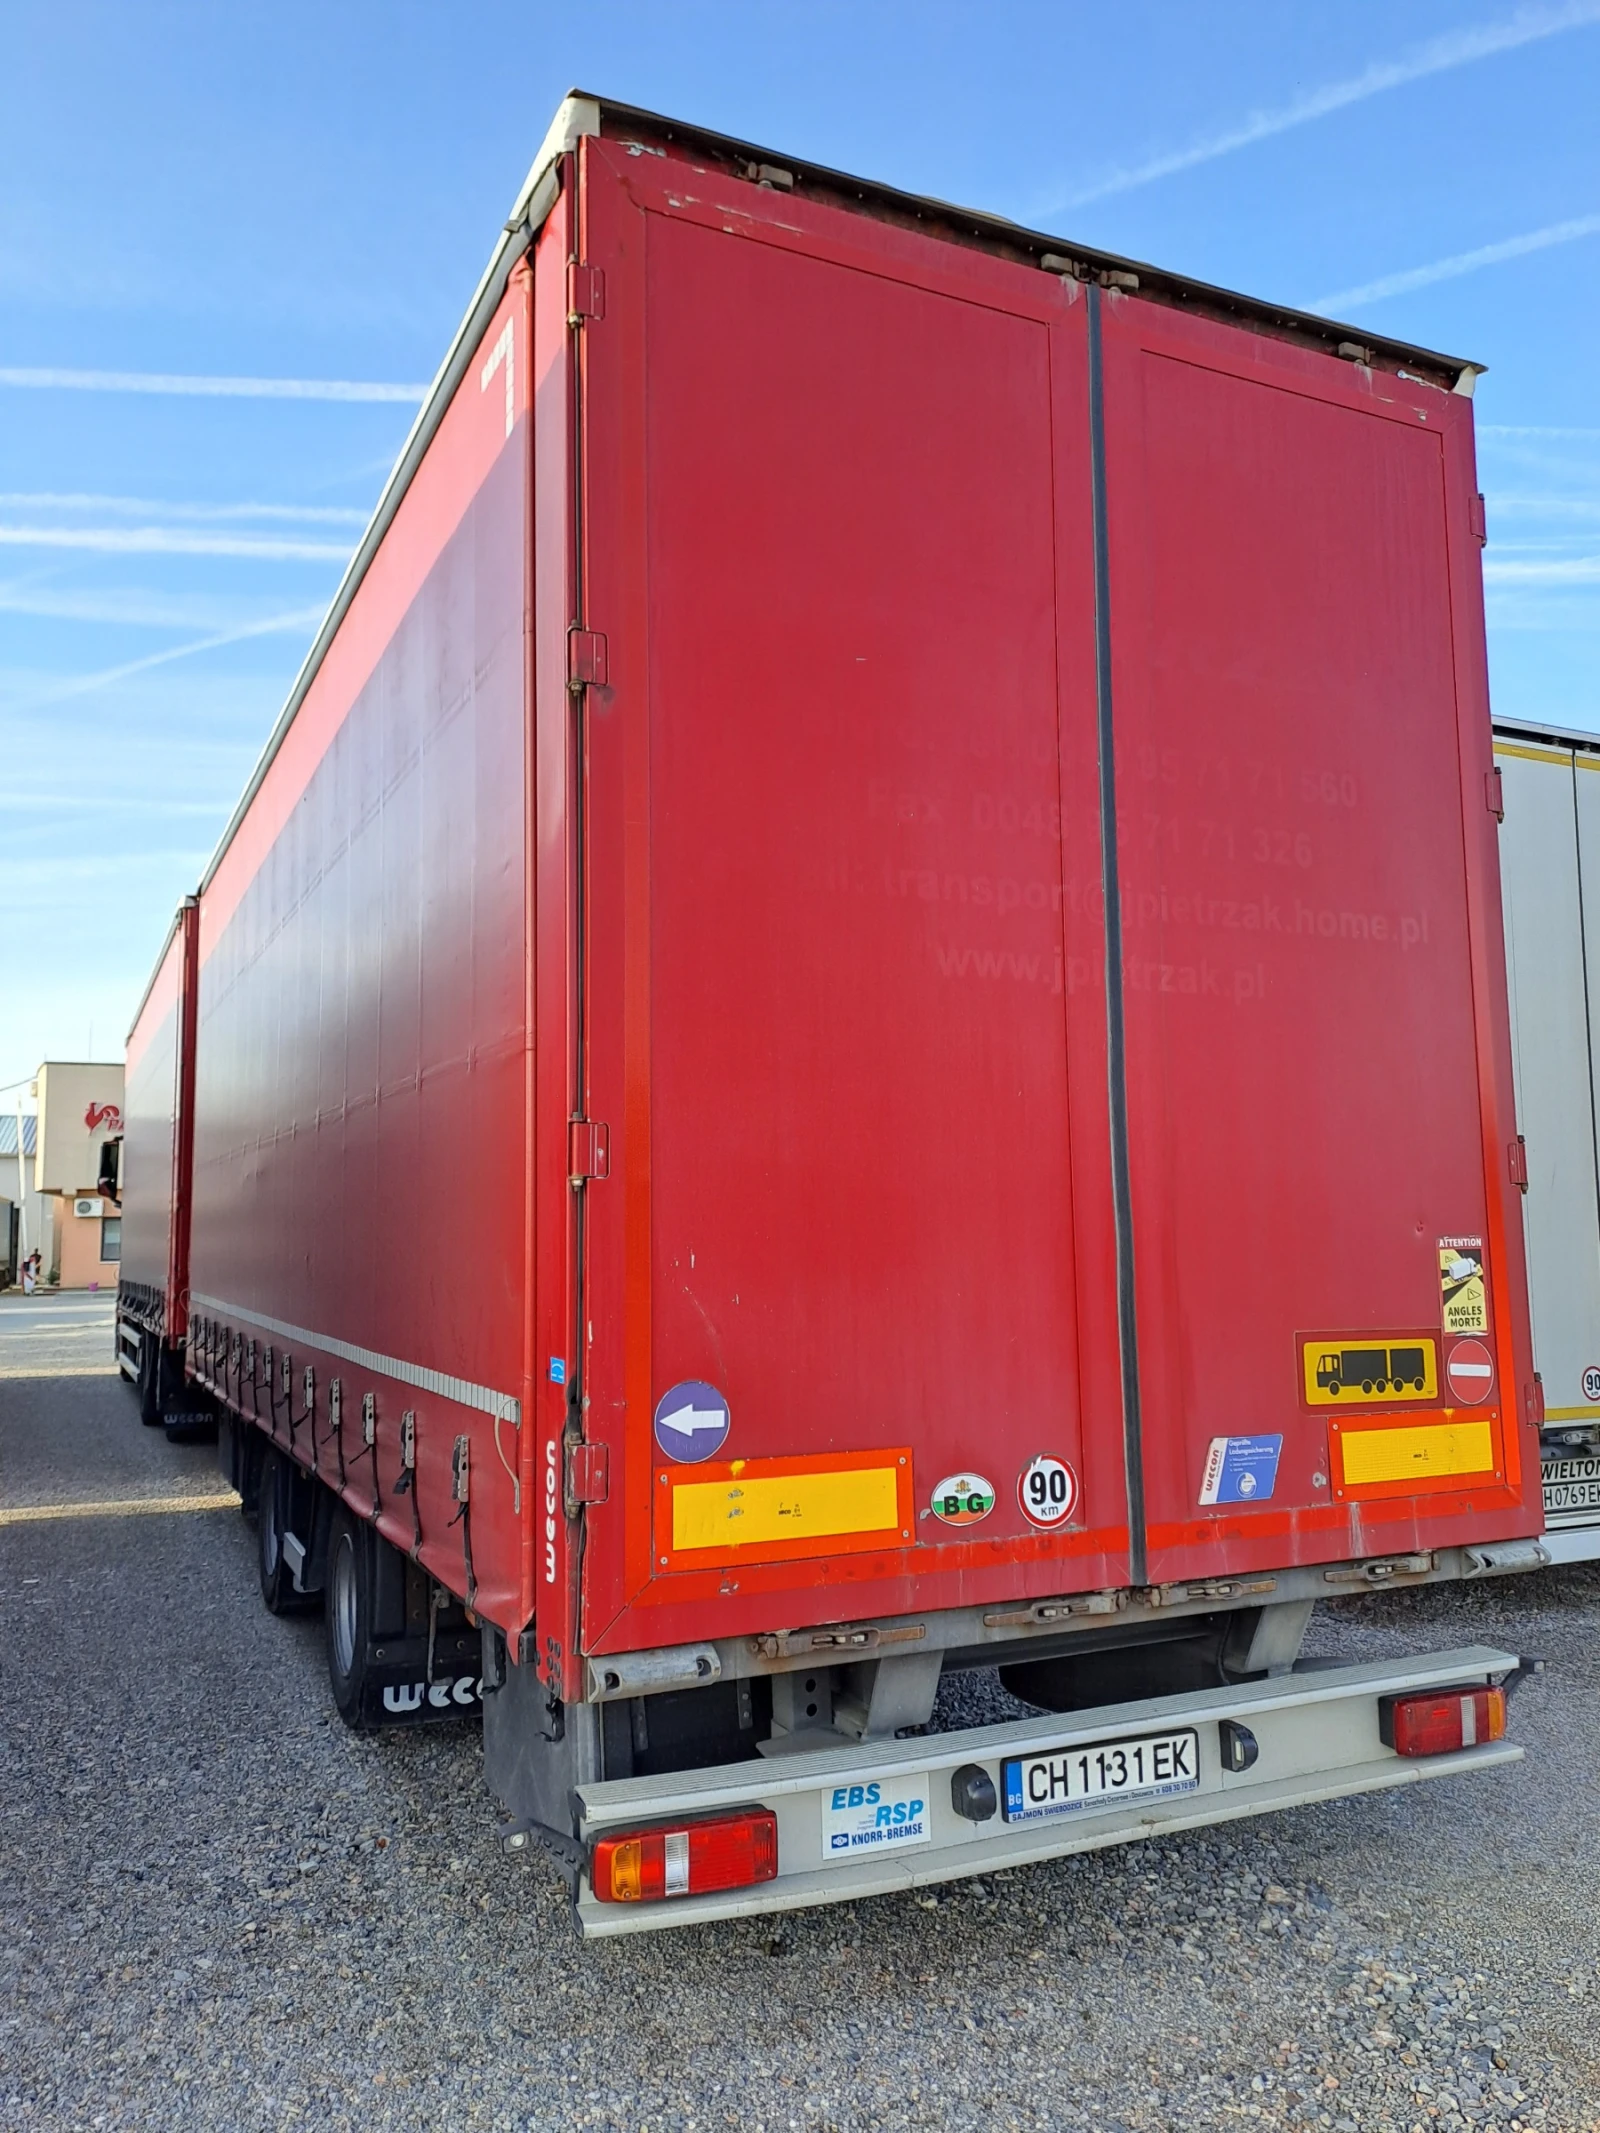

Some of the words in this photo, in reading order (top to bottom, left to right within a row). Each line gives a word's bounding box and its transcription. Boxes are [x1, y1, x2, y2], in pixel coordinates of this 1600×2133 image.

[937, 944, 1266, 1004] www.jpitrzak.pl
[1439, 1237, 1482, 1248] ATTENTION
[1448, 1305, 1482, 1317] ANGLES
[1450, 1316, 1482, 1328] MORTS
[1205, 1449, 1219, 1492] wecon
[1029, 1469, 1067, 1506] 90
[545, 1440, 556, 1583] wecon
[943, 1492, 985, 1517] BG
[383, 1676, 483, 1713] wec
[831, 1782, 881, 1810] EBS
[1008, 1793, 1022, 1806] BG
[875, 1799, 924, 1828] RSP
[851, 1822, 923, 1846] KNORR-BREMSE
